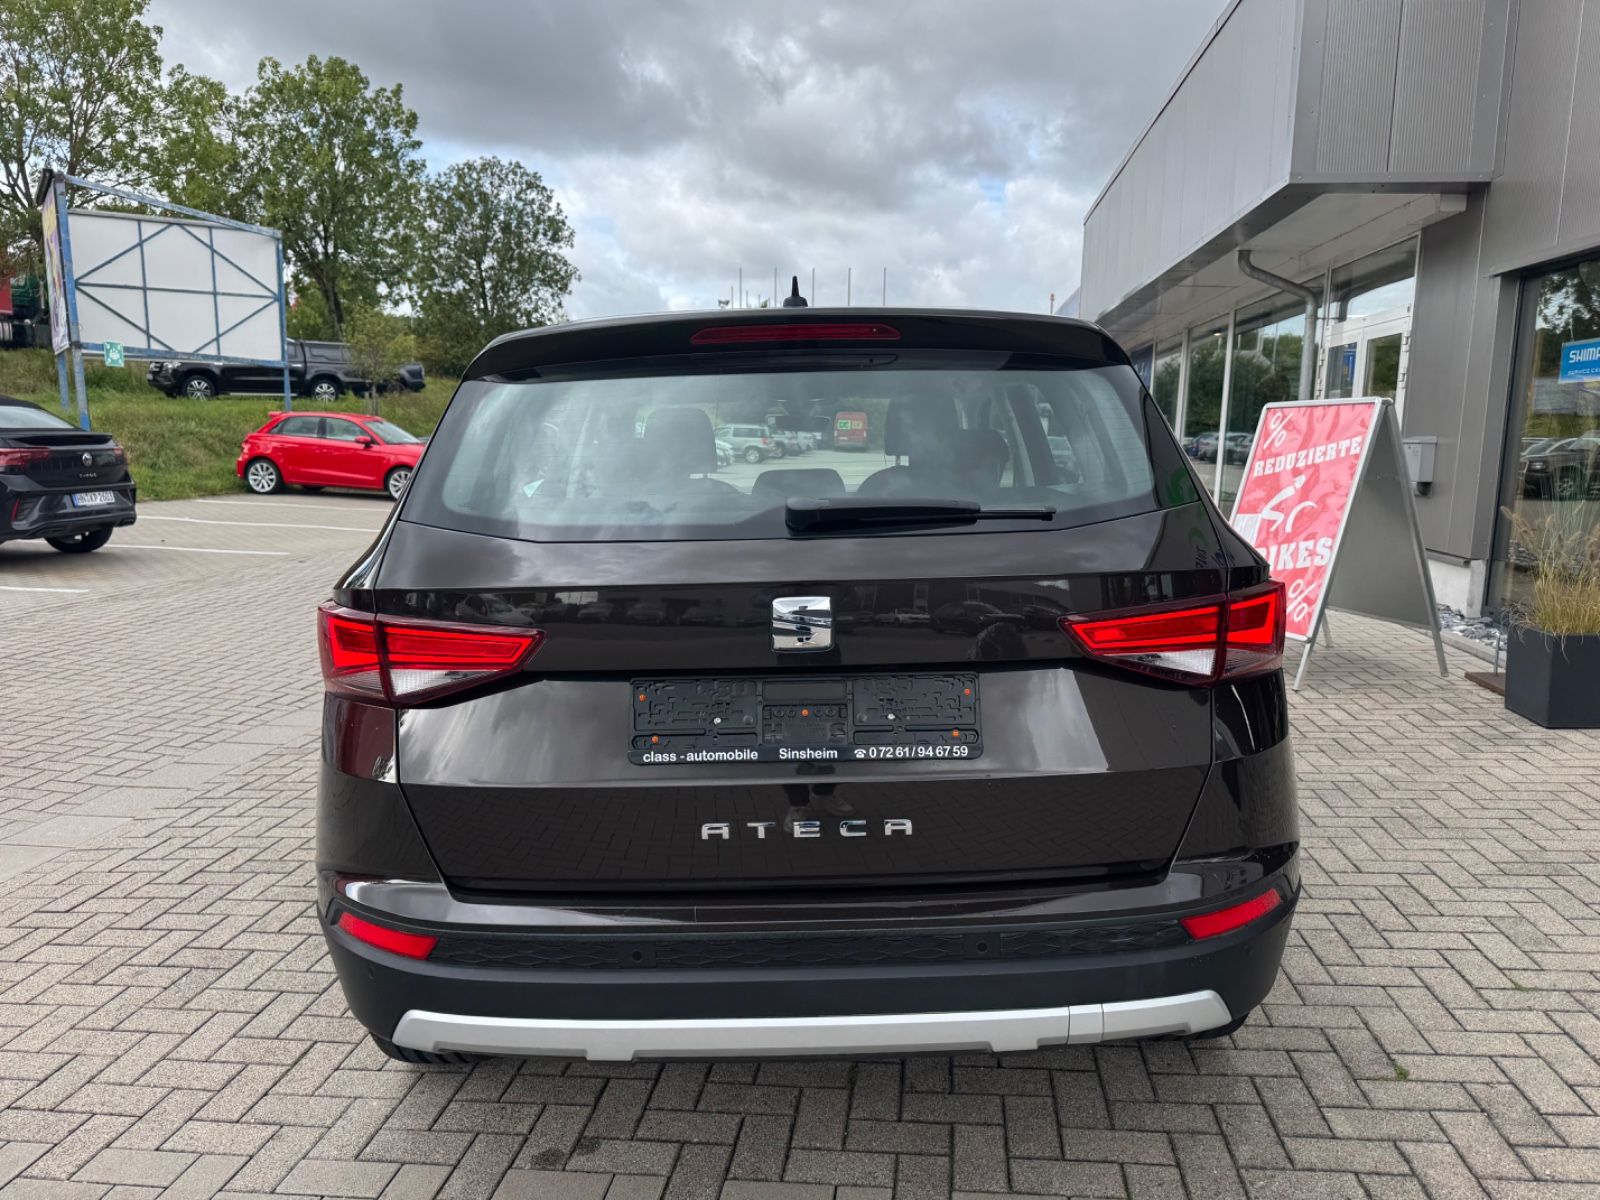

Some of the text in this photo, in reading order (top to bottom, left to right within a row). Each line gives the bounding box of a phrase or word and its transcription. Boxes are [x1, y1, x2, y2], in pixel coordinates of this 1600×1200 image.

[1254, 437, 1361, 475] REDUZIERTE
[779, 747, 838, 759] Sinsheim
[701, 818, 913, 840] ATECA
